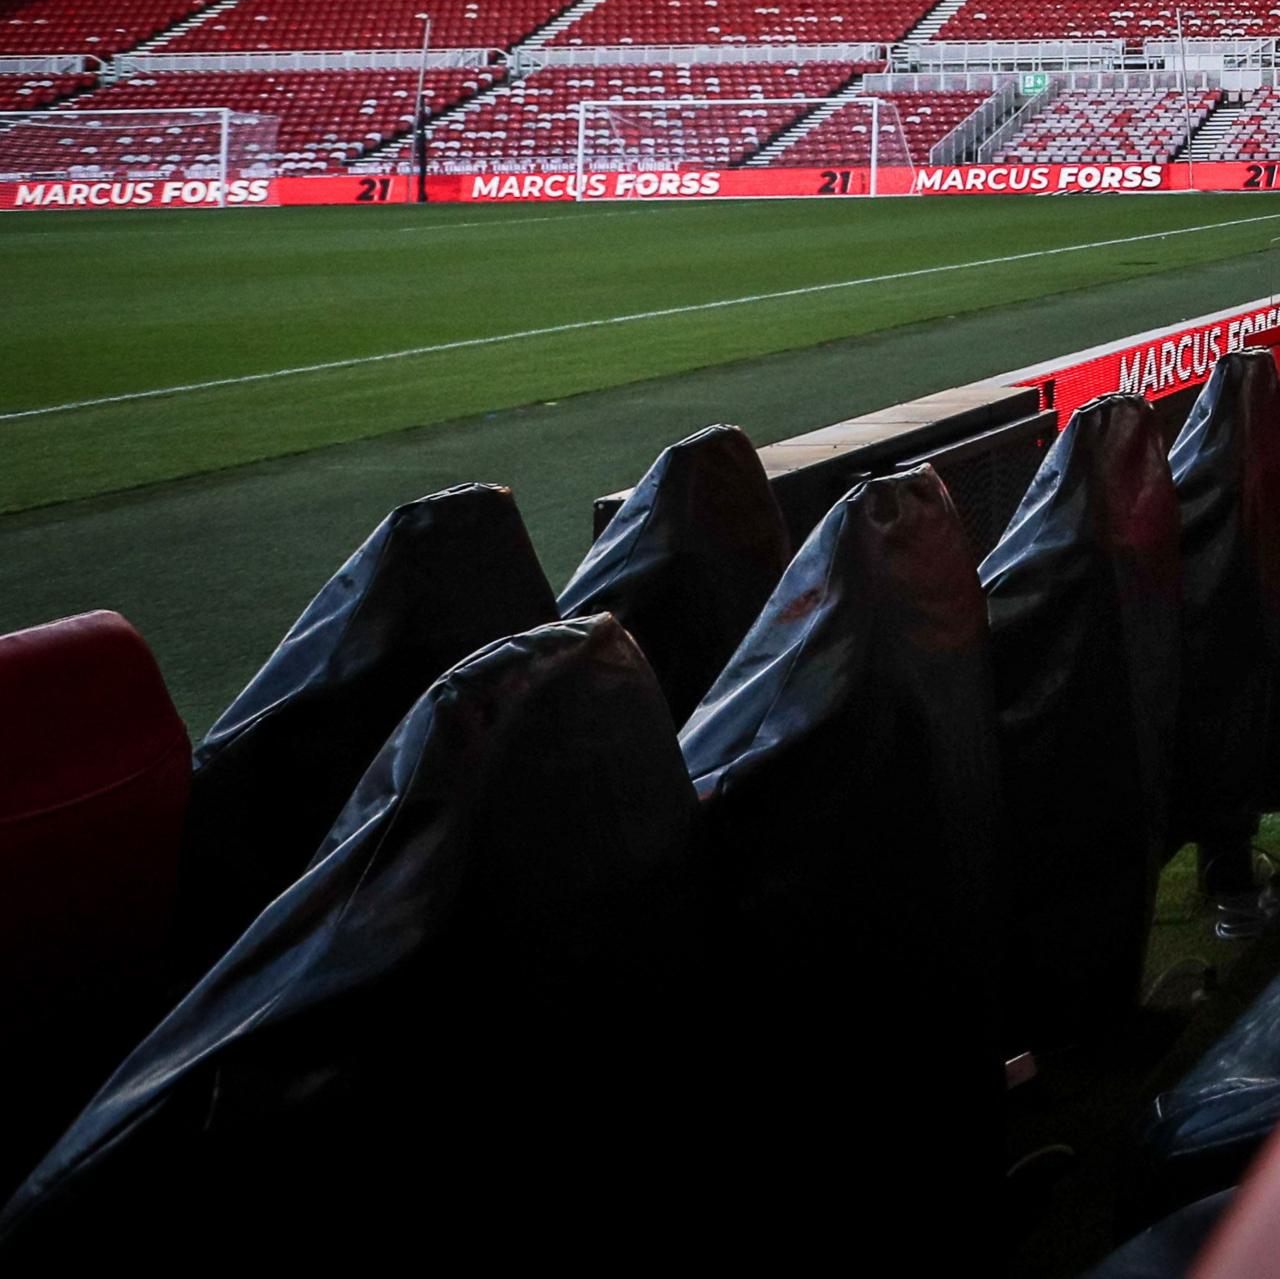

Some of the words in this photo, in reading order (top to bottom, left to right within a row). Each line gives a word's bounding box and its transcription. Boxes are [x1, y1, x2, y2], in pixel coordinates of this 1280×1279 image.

[472, 174, 607, 198] MARCUS
[615, 172, 720, 195] FORSS
[818, 170, 851, 194] 21
[916, 168, 1049, 191] MARCUS
[1058, 165, 1163, 189] FORSS
[1244, 164, 1278, 188] 21
[14, 182, 154, 206] MARCUS
[161, 179, 269, 203] FORSS
[356, 179, 392, 201] 21
[1117, 326, 1222, 396] MARCUS
